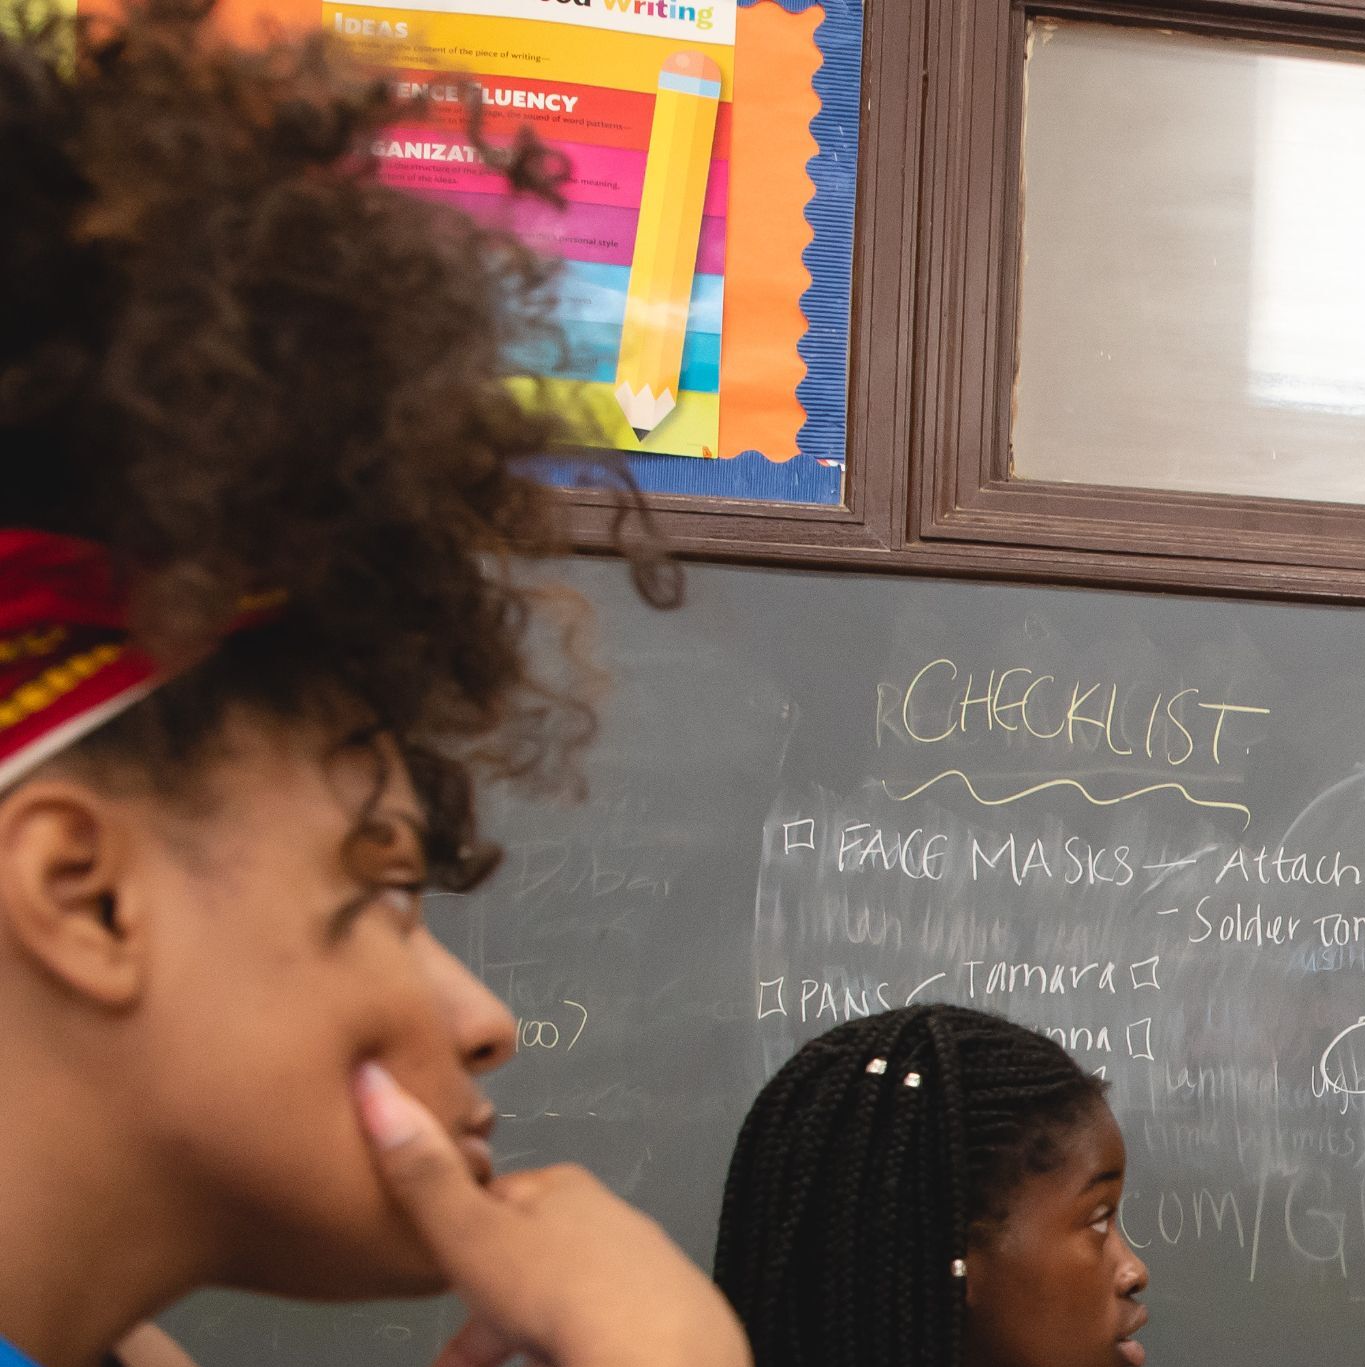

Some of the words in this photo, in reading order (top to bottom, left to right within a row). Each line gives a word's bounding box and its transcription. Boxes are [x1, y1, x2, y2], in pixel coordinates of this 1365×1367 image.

[602, 0, 714, 30] Writing
[459, 47, 474, 56] the
[475, 49, 498, 59] piece
[499, 50, 509, 58] of
[598, 239, 619, 250] style
[903, 658, 1270, 765] CHECKLIST
[972, 833, 1134, 886] MASKS
[1215, 846, 1362, 887] Attach
[963, 959, 1116, 998] Tamara
[1038, 1023, 1112, 1053] nna
